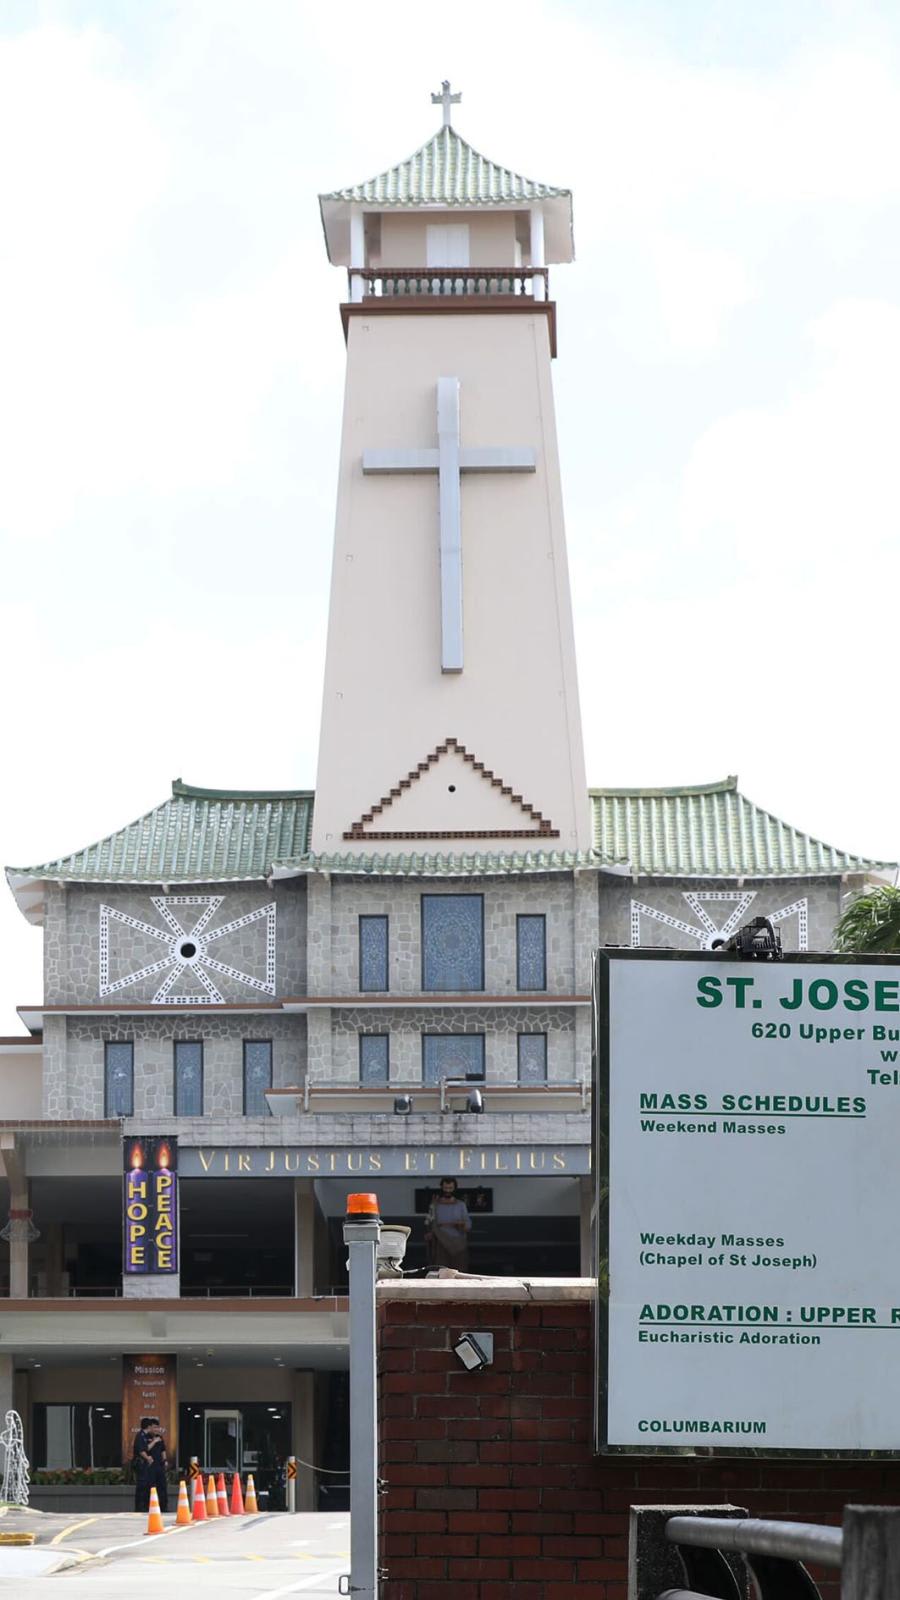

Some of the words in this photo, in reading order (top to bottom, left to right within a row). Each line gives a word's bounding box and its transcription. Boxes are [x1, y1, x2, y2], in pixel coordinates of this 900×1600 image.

[696, 976, 762, 1009] ST.
[779, 978, 900, 1012] JOSE
[752, 1023, 791, 1039] 620
[800, 1024, 865, 1043] Upper
[872, 1025, 900, 1042] Bu
[640, 1093, 708, 1110] MASS
[721, 1095, 867, 1113] SCHEDULES
[640, 1120, 717, 1134] Weekend
[722, 1122, 786, 1135] Masses
[127, 1182, 148, 1264] HOPE
[155, 1176, 173, 1268] PEACE
[640, 1233, 716, 1248] Weekday
[721, 1234, 785, 1248] Masses
[639, 1251, 703, 1268] (Chapel
[708, 1254, 725, 1266] of
[729, 1254, 747, 1267] St
[751, 1254, 817, 1269] Joseph)
[639, 1304, 779, 1322] ADORATION
[800, 1306, 877, 1323] UPPER
[638, 1331, 734, 1344] Eucharistic
[739, 1332, 821, 1345] Adoration
[134, 1366, 165, 1374] Mission
[638, 1420, 767, 1434] COLUMBARIUM
